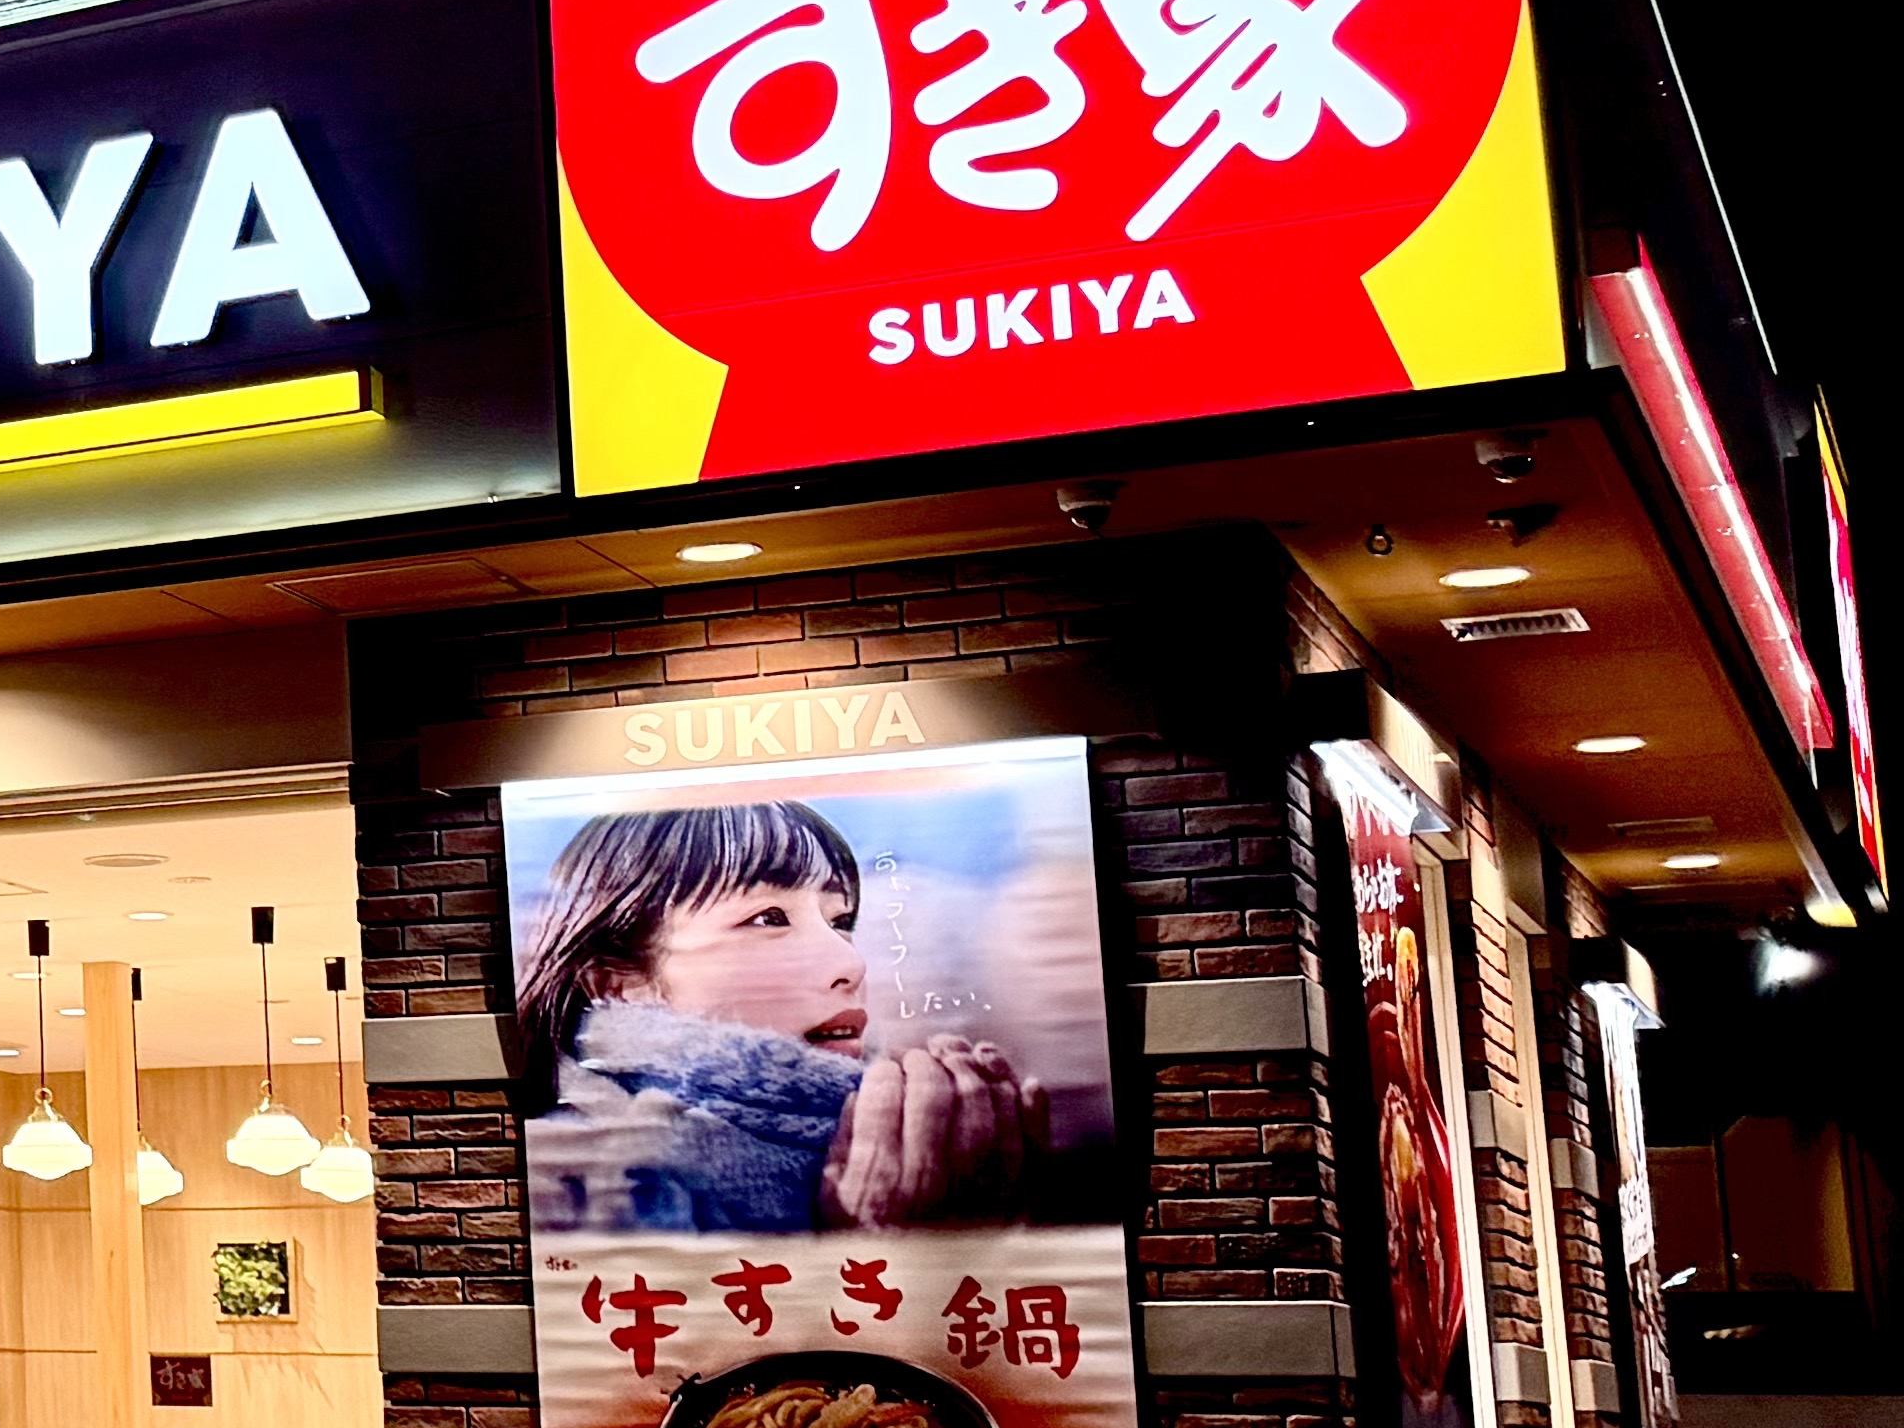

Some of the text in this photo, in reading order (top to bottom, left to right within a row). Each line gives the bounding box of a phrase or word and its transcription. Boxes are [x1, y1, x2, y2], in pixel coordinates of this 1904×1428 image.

[867, 267, 1196, 365] SUKIYA
[622, 691, 925, 769] SUKIYA
[581, 1257, 1081, 1380] 牛すき鍋
